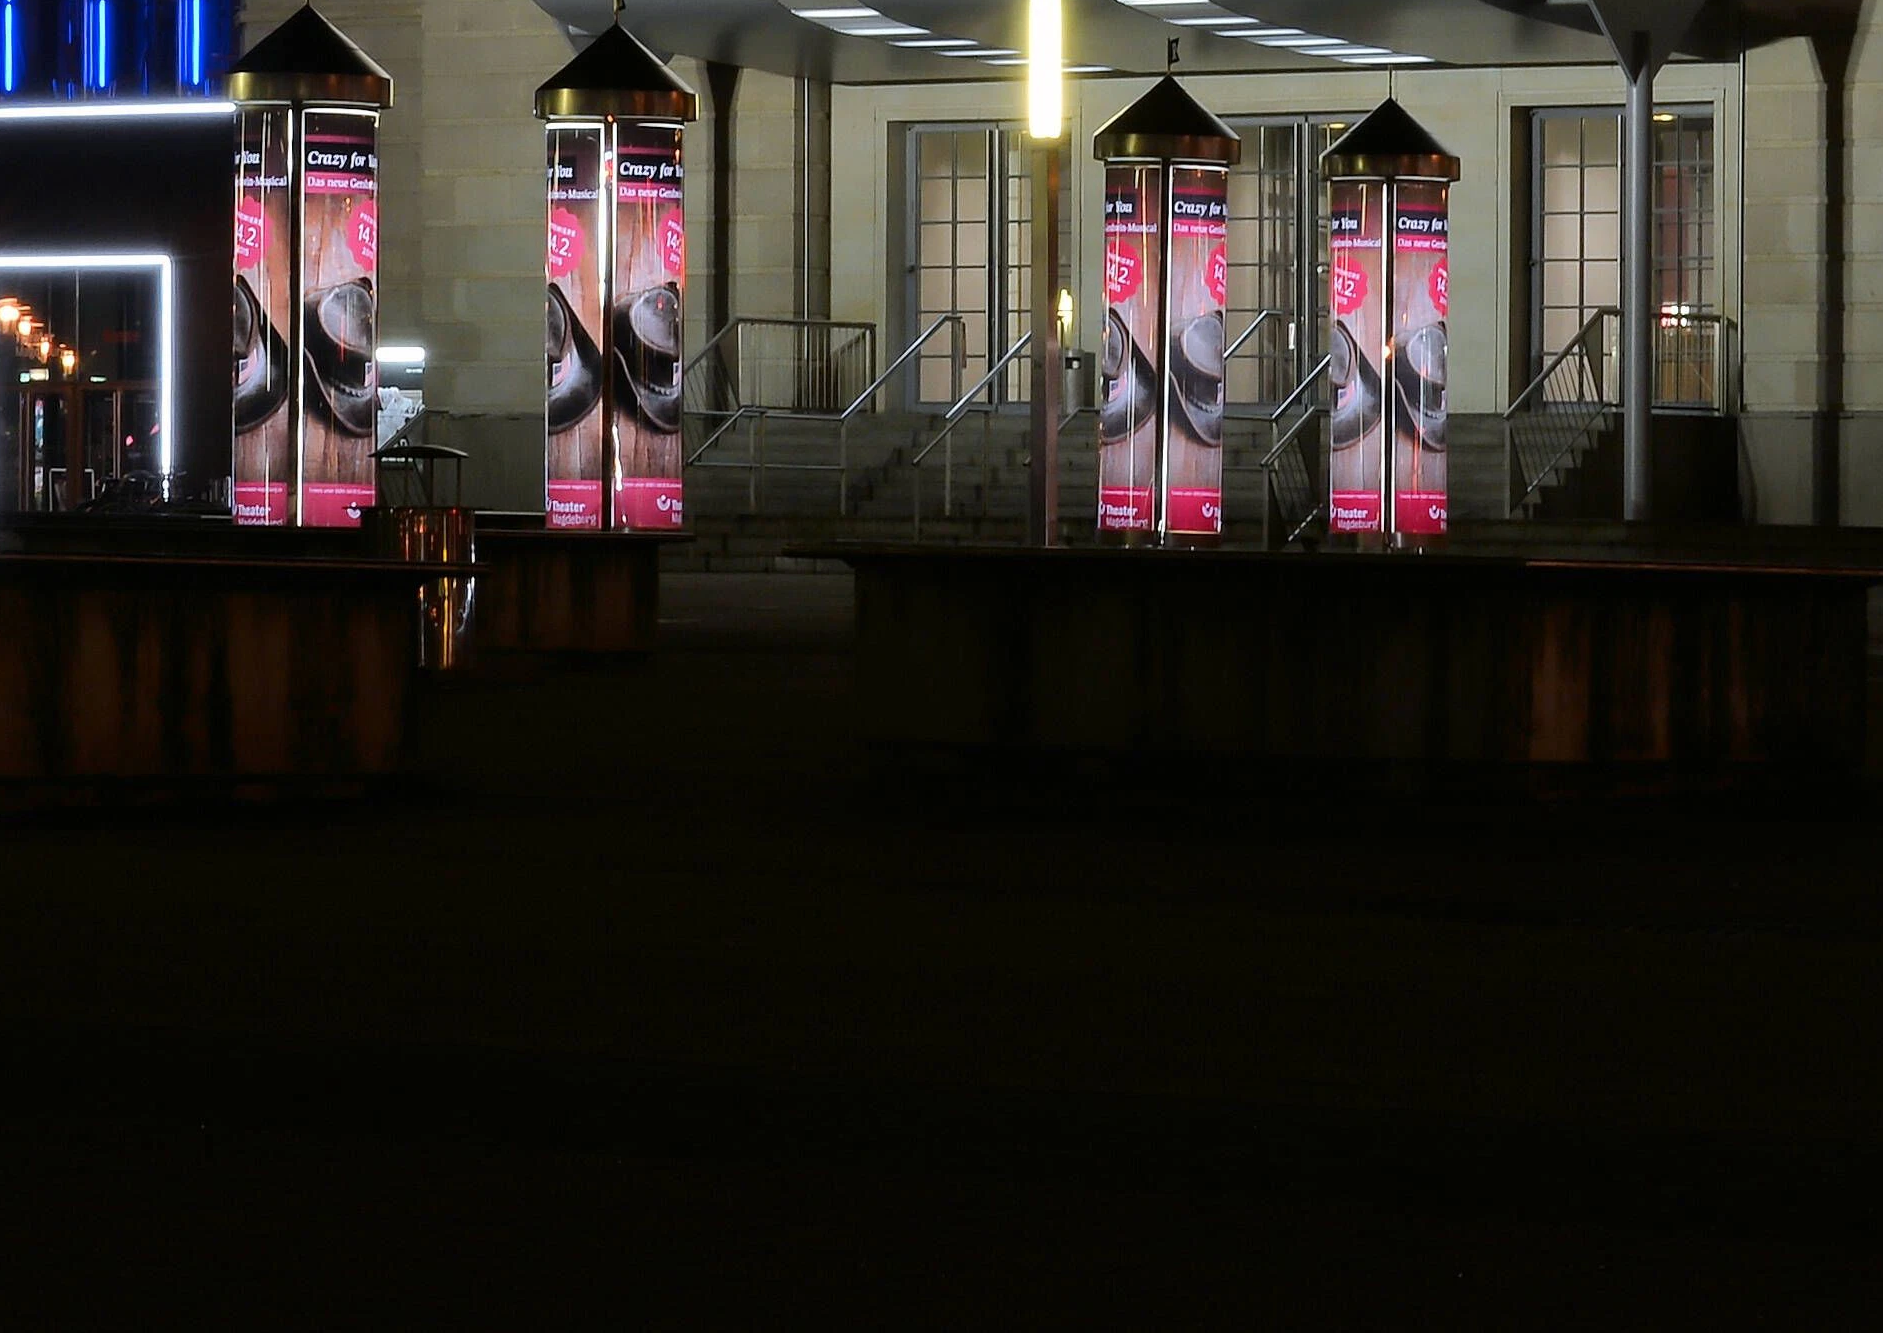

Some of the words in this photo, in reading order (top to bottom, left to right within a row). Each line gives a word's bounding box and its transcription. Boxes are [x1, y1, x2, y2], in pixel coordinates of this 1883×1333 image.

[307, 150, 347, 169] Crazy
[350, 151, 367, 169] for
[619, 162, 657, 179] Crazy
[659, 163, 674, 179] for
[306, 177, 325, 187] Das
